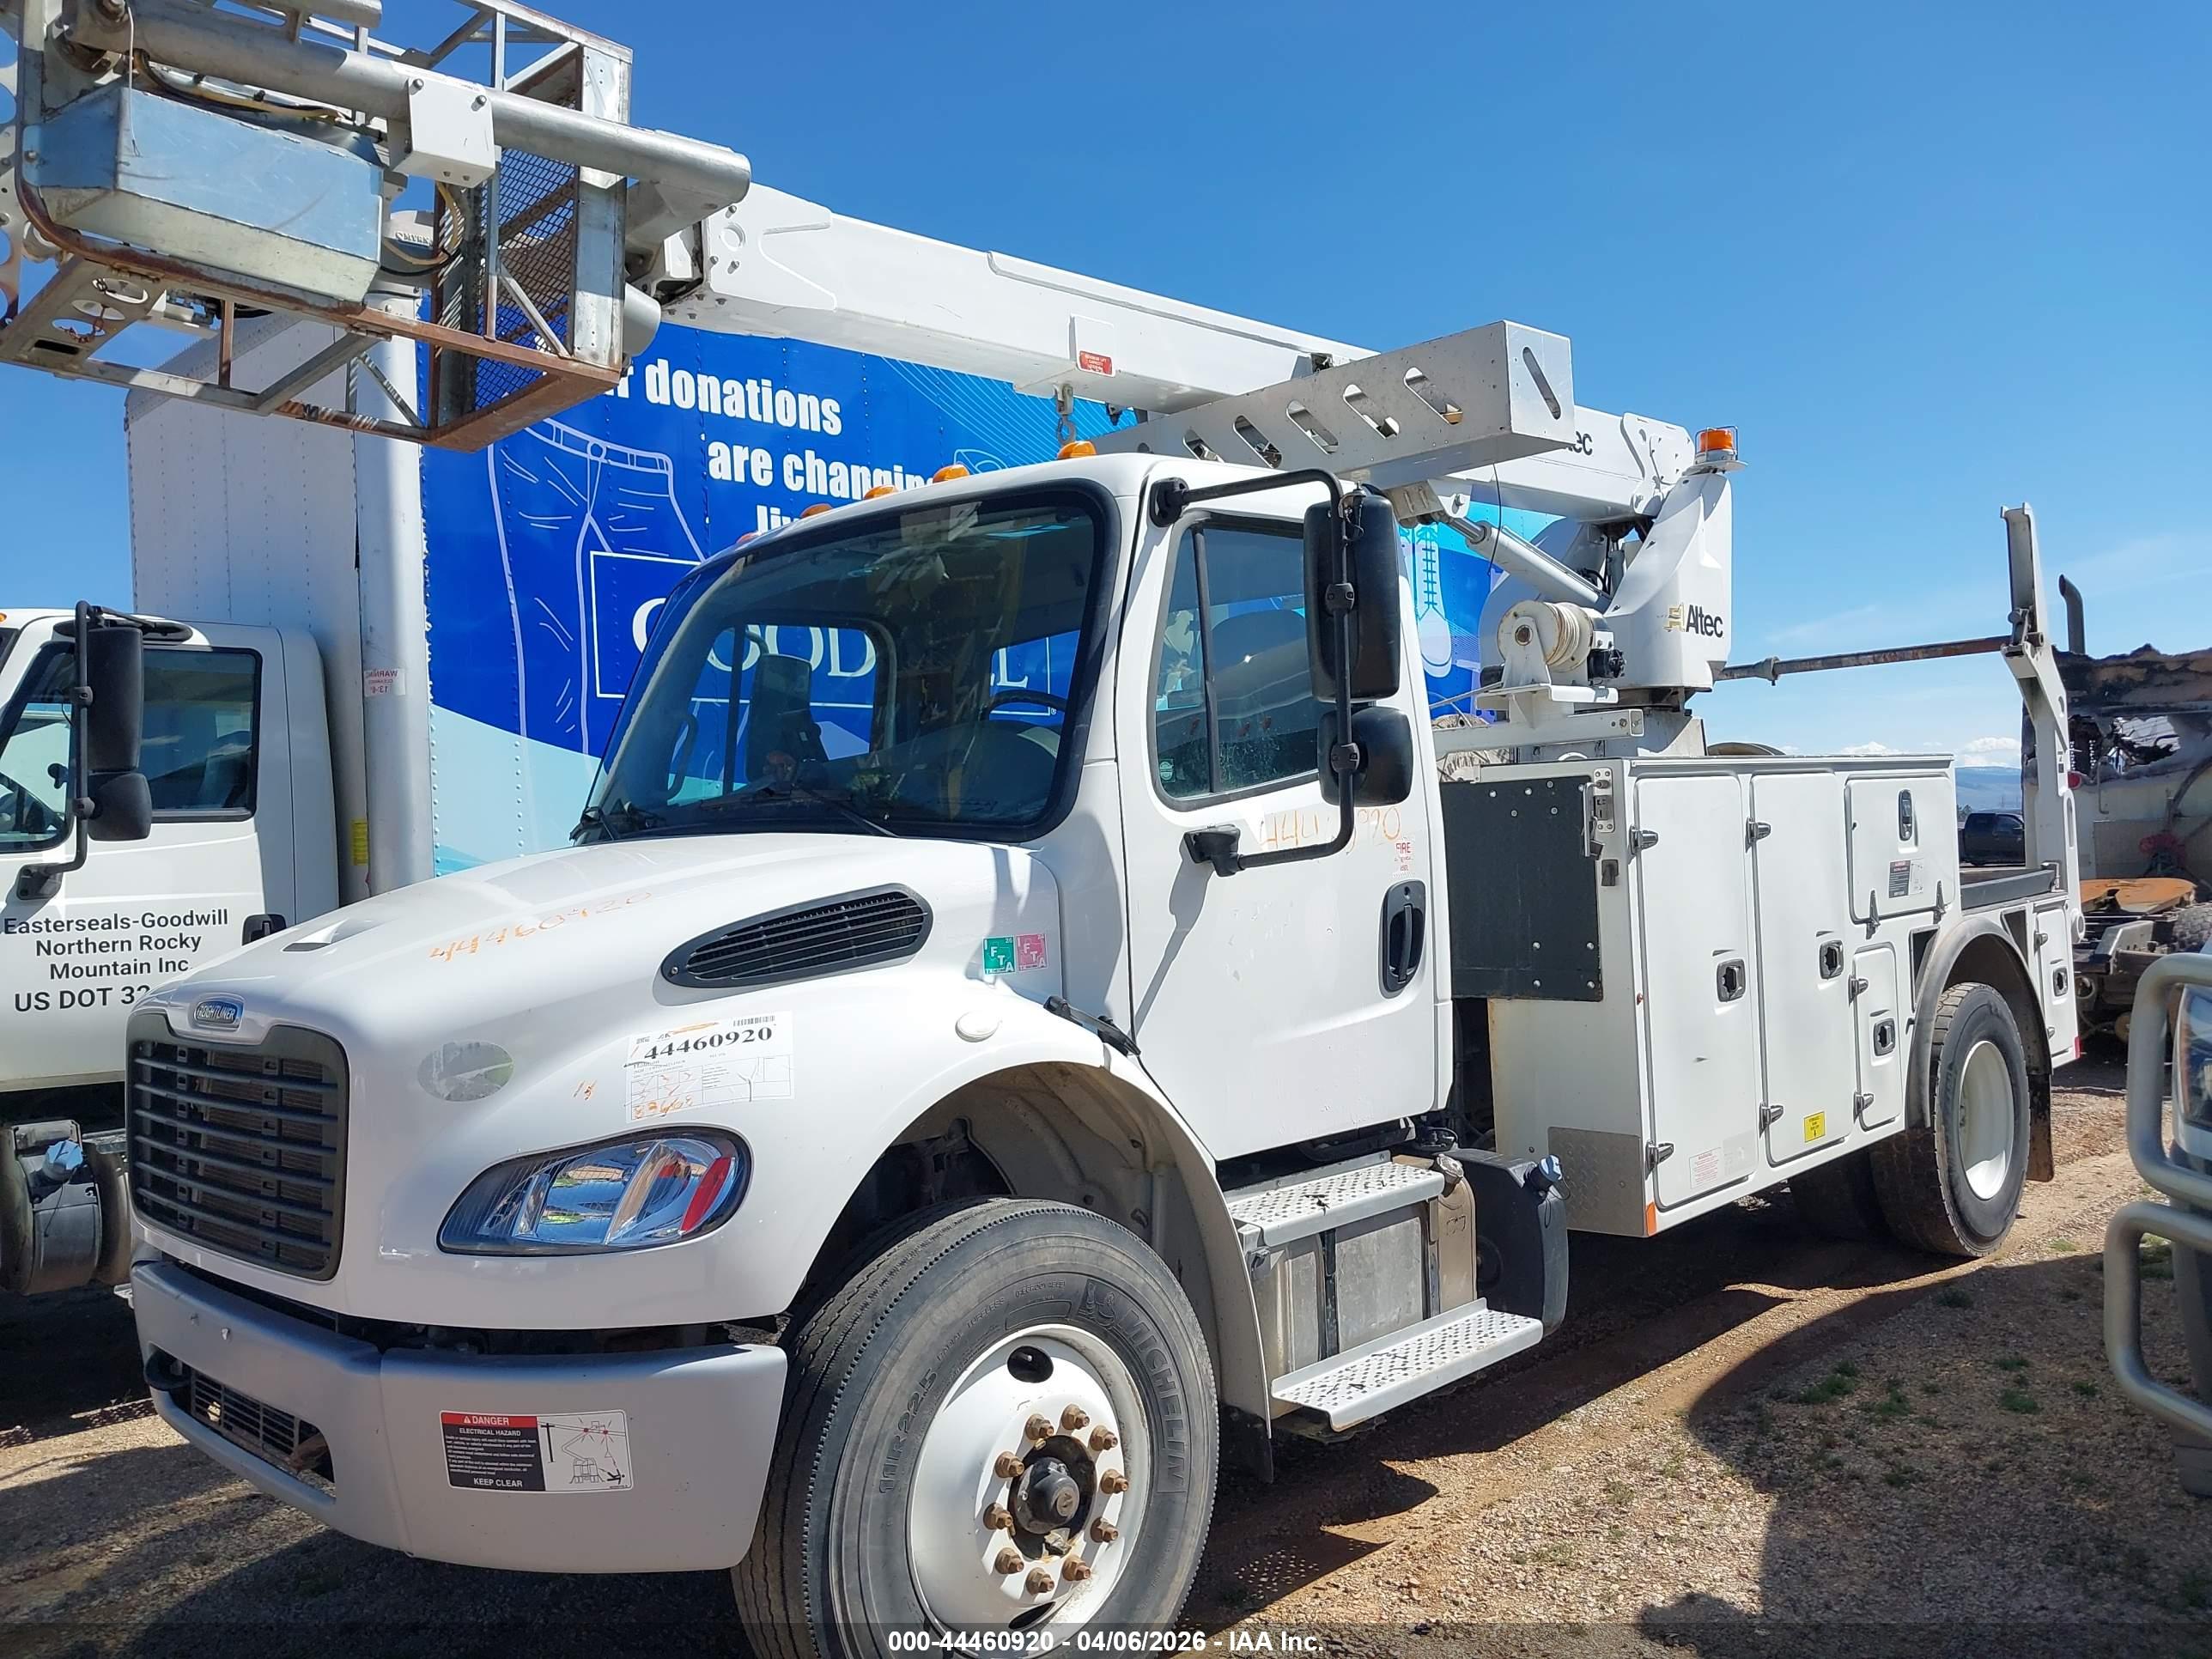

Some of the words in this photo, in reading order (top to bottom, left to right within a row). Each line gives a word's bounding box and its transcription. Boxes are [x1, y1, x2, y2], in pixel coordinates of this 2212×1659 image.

[645, 358, 842, 436] donations
[708, 441, 774, 487] are
[782, 448, 933, 501] chani
[1686, 604, 1724, 639] Altec
[3, 908, 229, 935] Easterseals-Goodwill
[35, 936, 132, 957] Northern
[138, 934, 202, 953] Rocky
[50, 960, 152, 980] Mountain
[14, 992, 51, 1012] US
[59, 987, 113, 1010] DOT
[643, 1026, 774, 1060] 44460920
[1119, 1310, 1186, 1486] MICHELIN
[459, 1427, 495, 1436] ELECTRICAL
[472, 1415, 510, 1426] DANGER
[473, 1477, 495, 1486] KEEP
[495, 1479, 523, 1487] CLEAR
